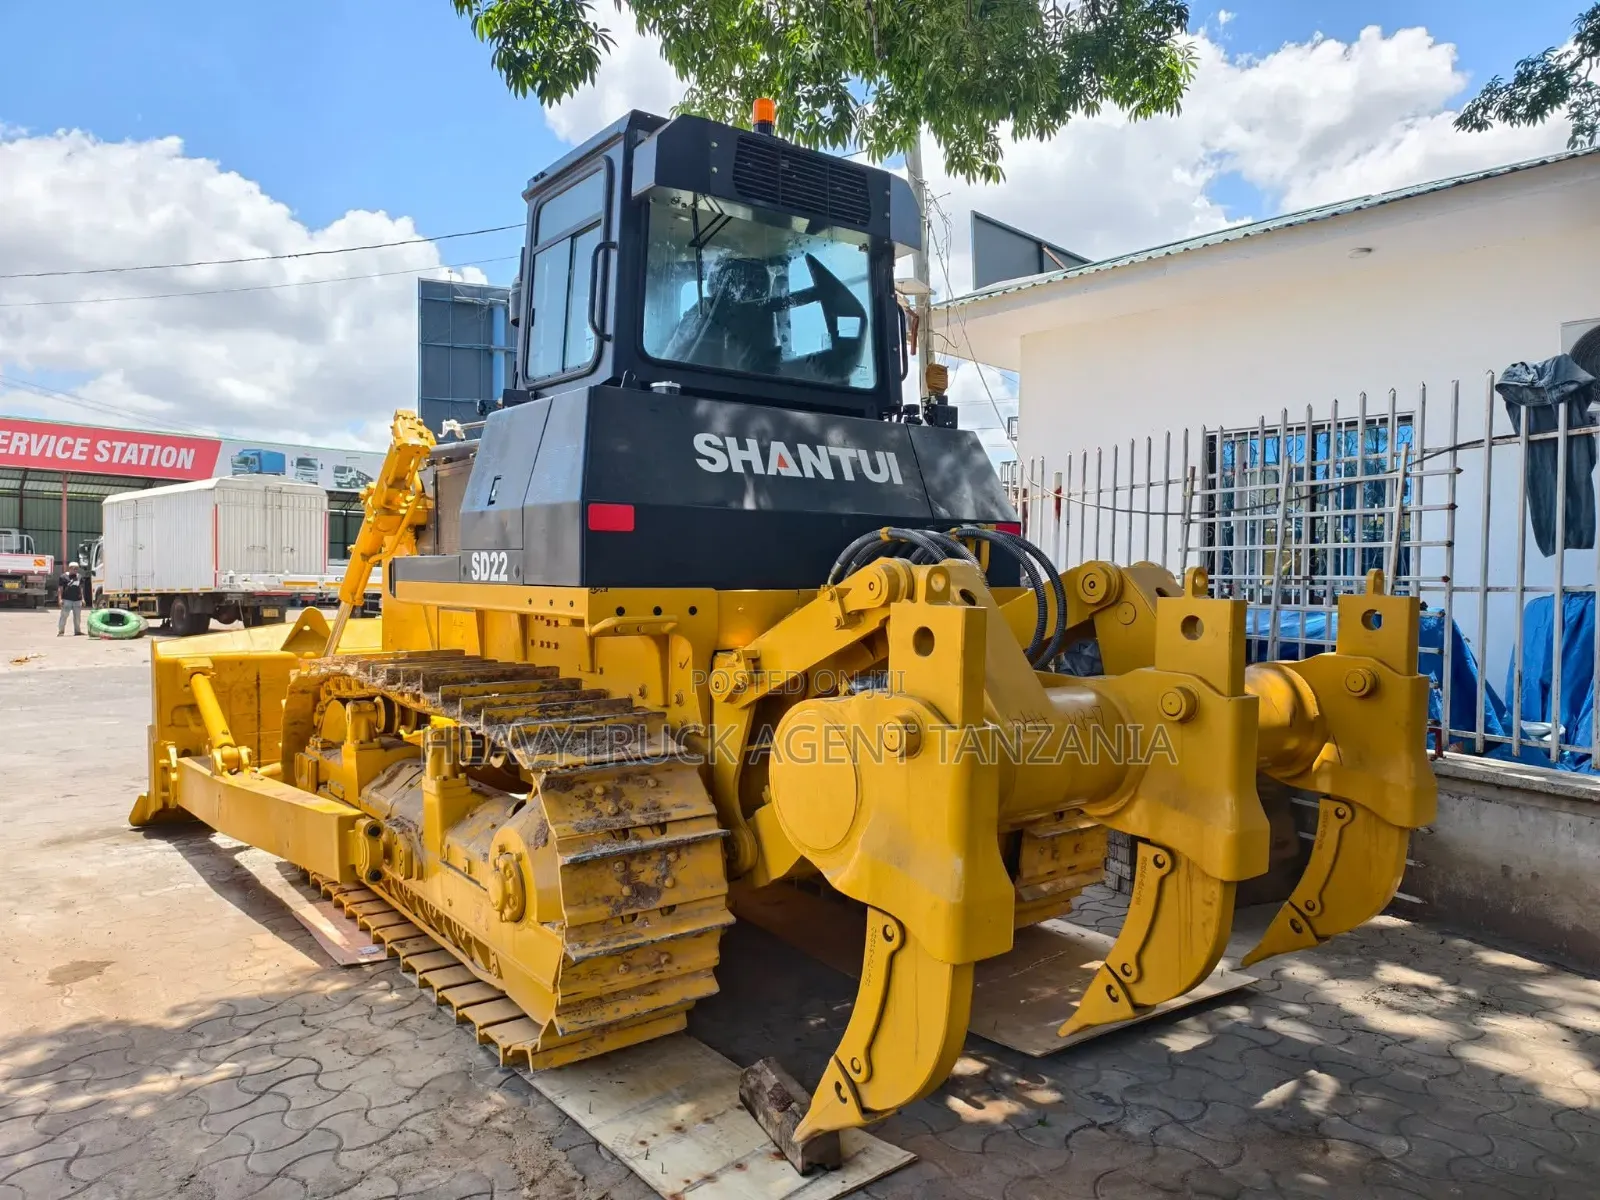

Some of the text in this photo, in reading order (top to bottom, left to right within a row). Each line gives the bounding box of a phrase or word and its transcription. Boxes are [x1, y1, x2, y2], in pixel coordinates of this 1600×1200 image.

[94, 439, 196, 470] STATION
[693, 432, 903, 485] SHANTUI
[471, 551, 508, 582] SD22
